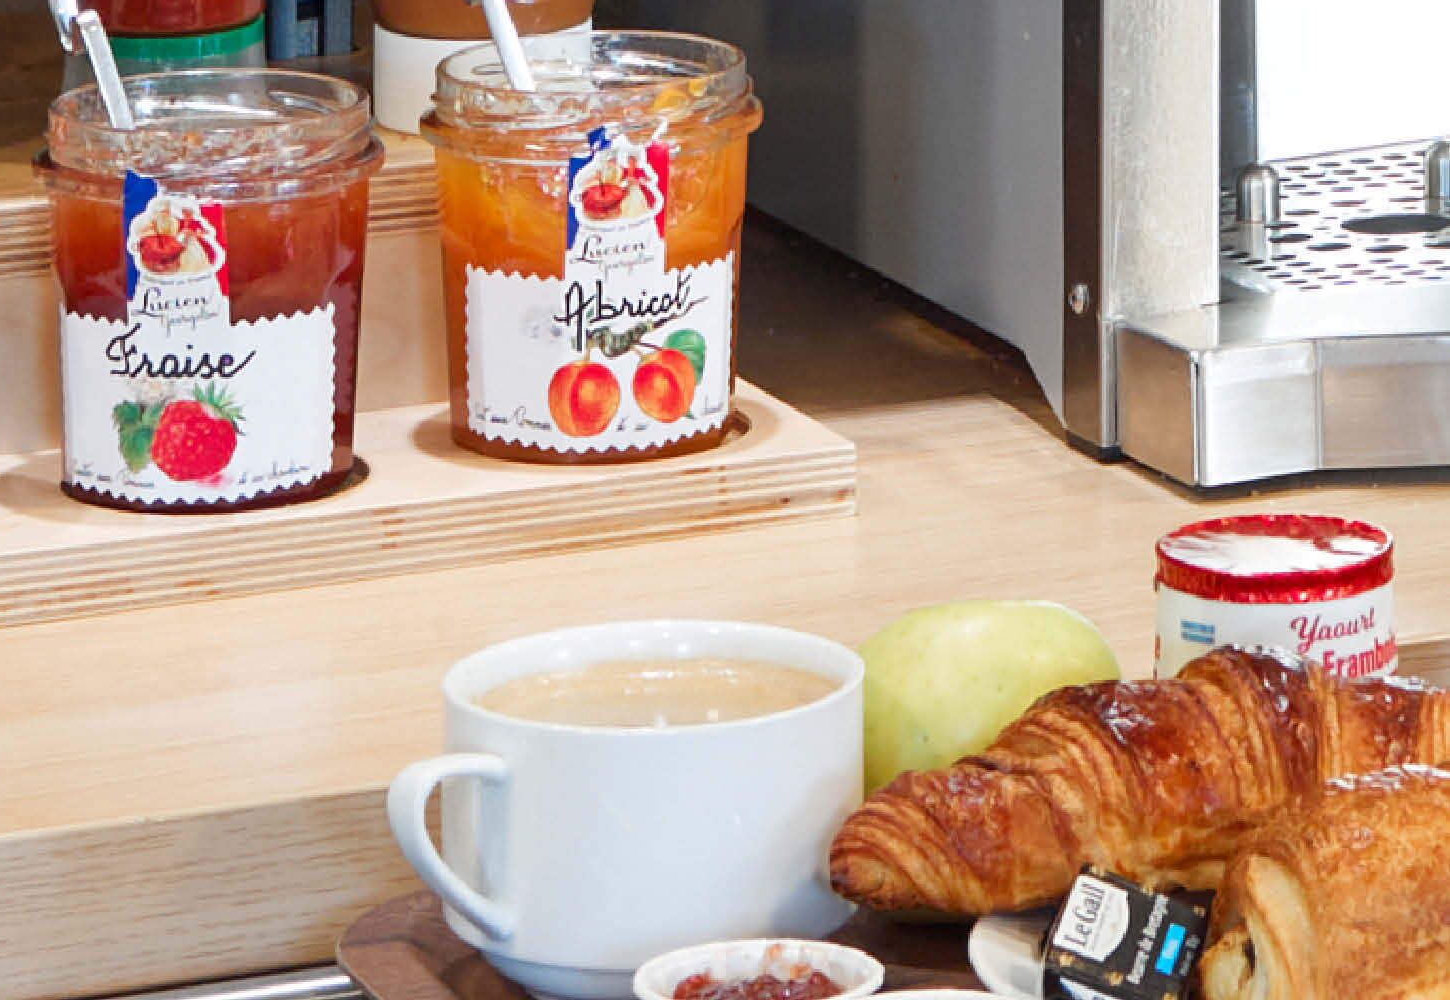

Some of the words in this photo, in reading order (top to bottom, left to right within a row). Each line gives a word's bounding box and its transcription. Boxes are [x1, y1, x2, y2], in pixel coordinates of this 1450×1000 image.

[554, 271, 693, 352] Abricot
[104, 322, 257, 379] Fraise
[1290, 606, 1376, 654] Yaourt
